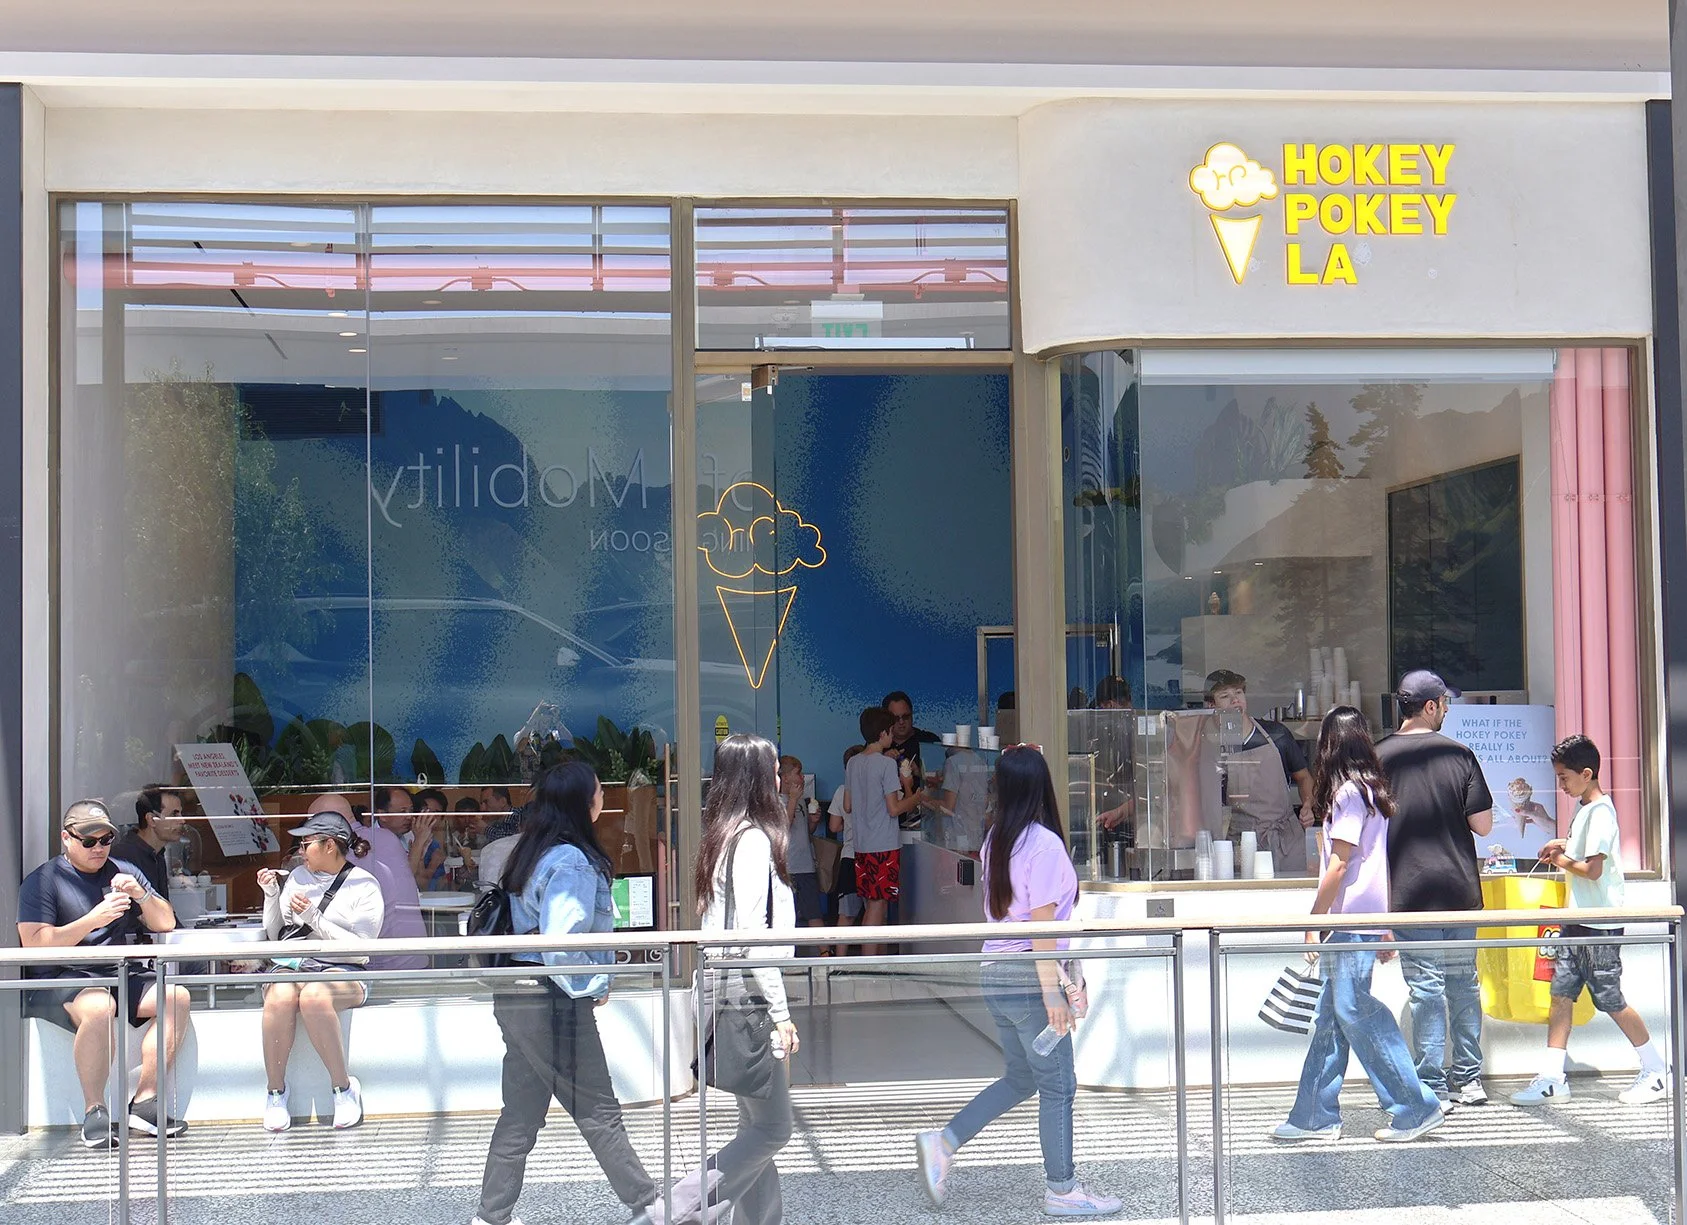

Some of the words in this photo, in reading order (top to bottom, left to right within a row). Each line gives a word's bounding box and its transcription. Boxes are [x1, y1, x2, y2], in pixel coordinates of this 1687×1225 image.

[1283, 143, 1456, 186] HOKEY
[1284, 193, 1457, 235] POKEY
[1286, 243, 1358, 285] LA
[1461, 719, 1490, 728] WHAT
[1493, 719, 1501, 727] IF
[1504, 719, 1522, 727] THE
[1456, 730, 1490, 739] HOKEY
[1494, 731, 1527, 739] POKEY
[1469, 742, 1502, 751] REALLY
[1506, 742, 1515, 751] IS
[1487, 755, 1503, 763] ALL
[1507, 755, 1548, 764] ABOUT?
